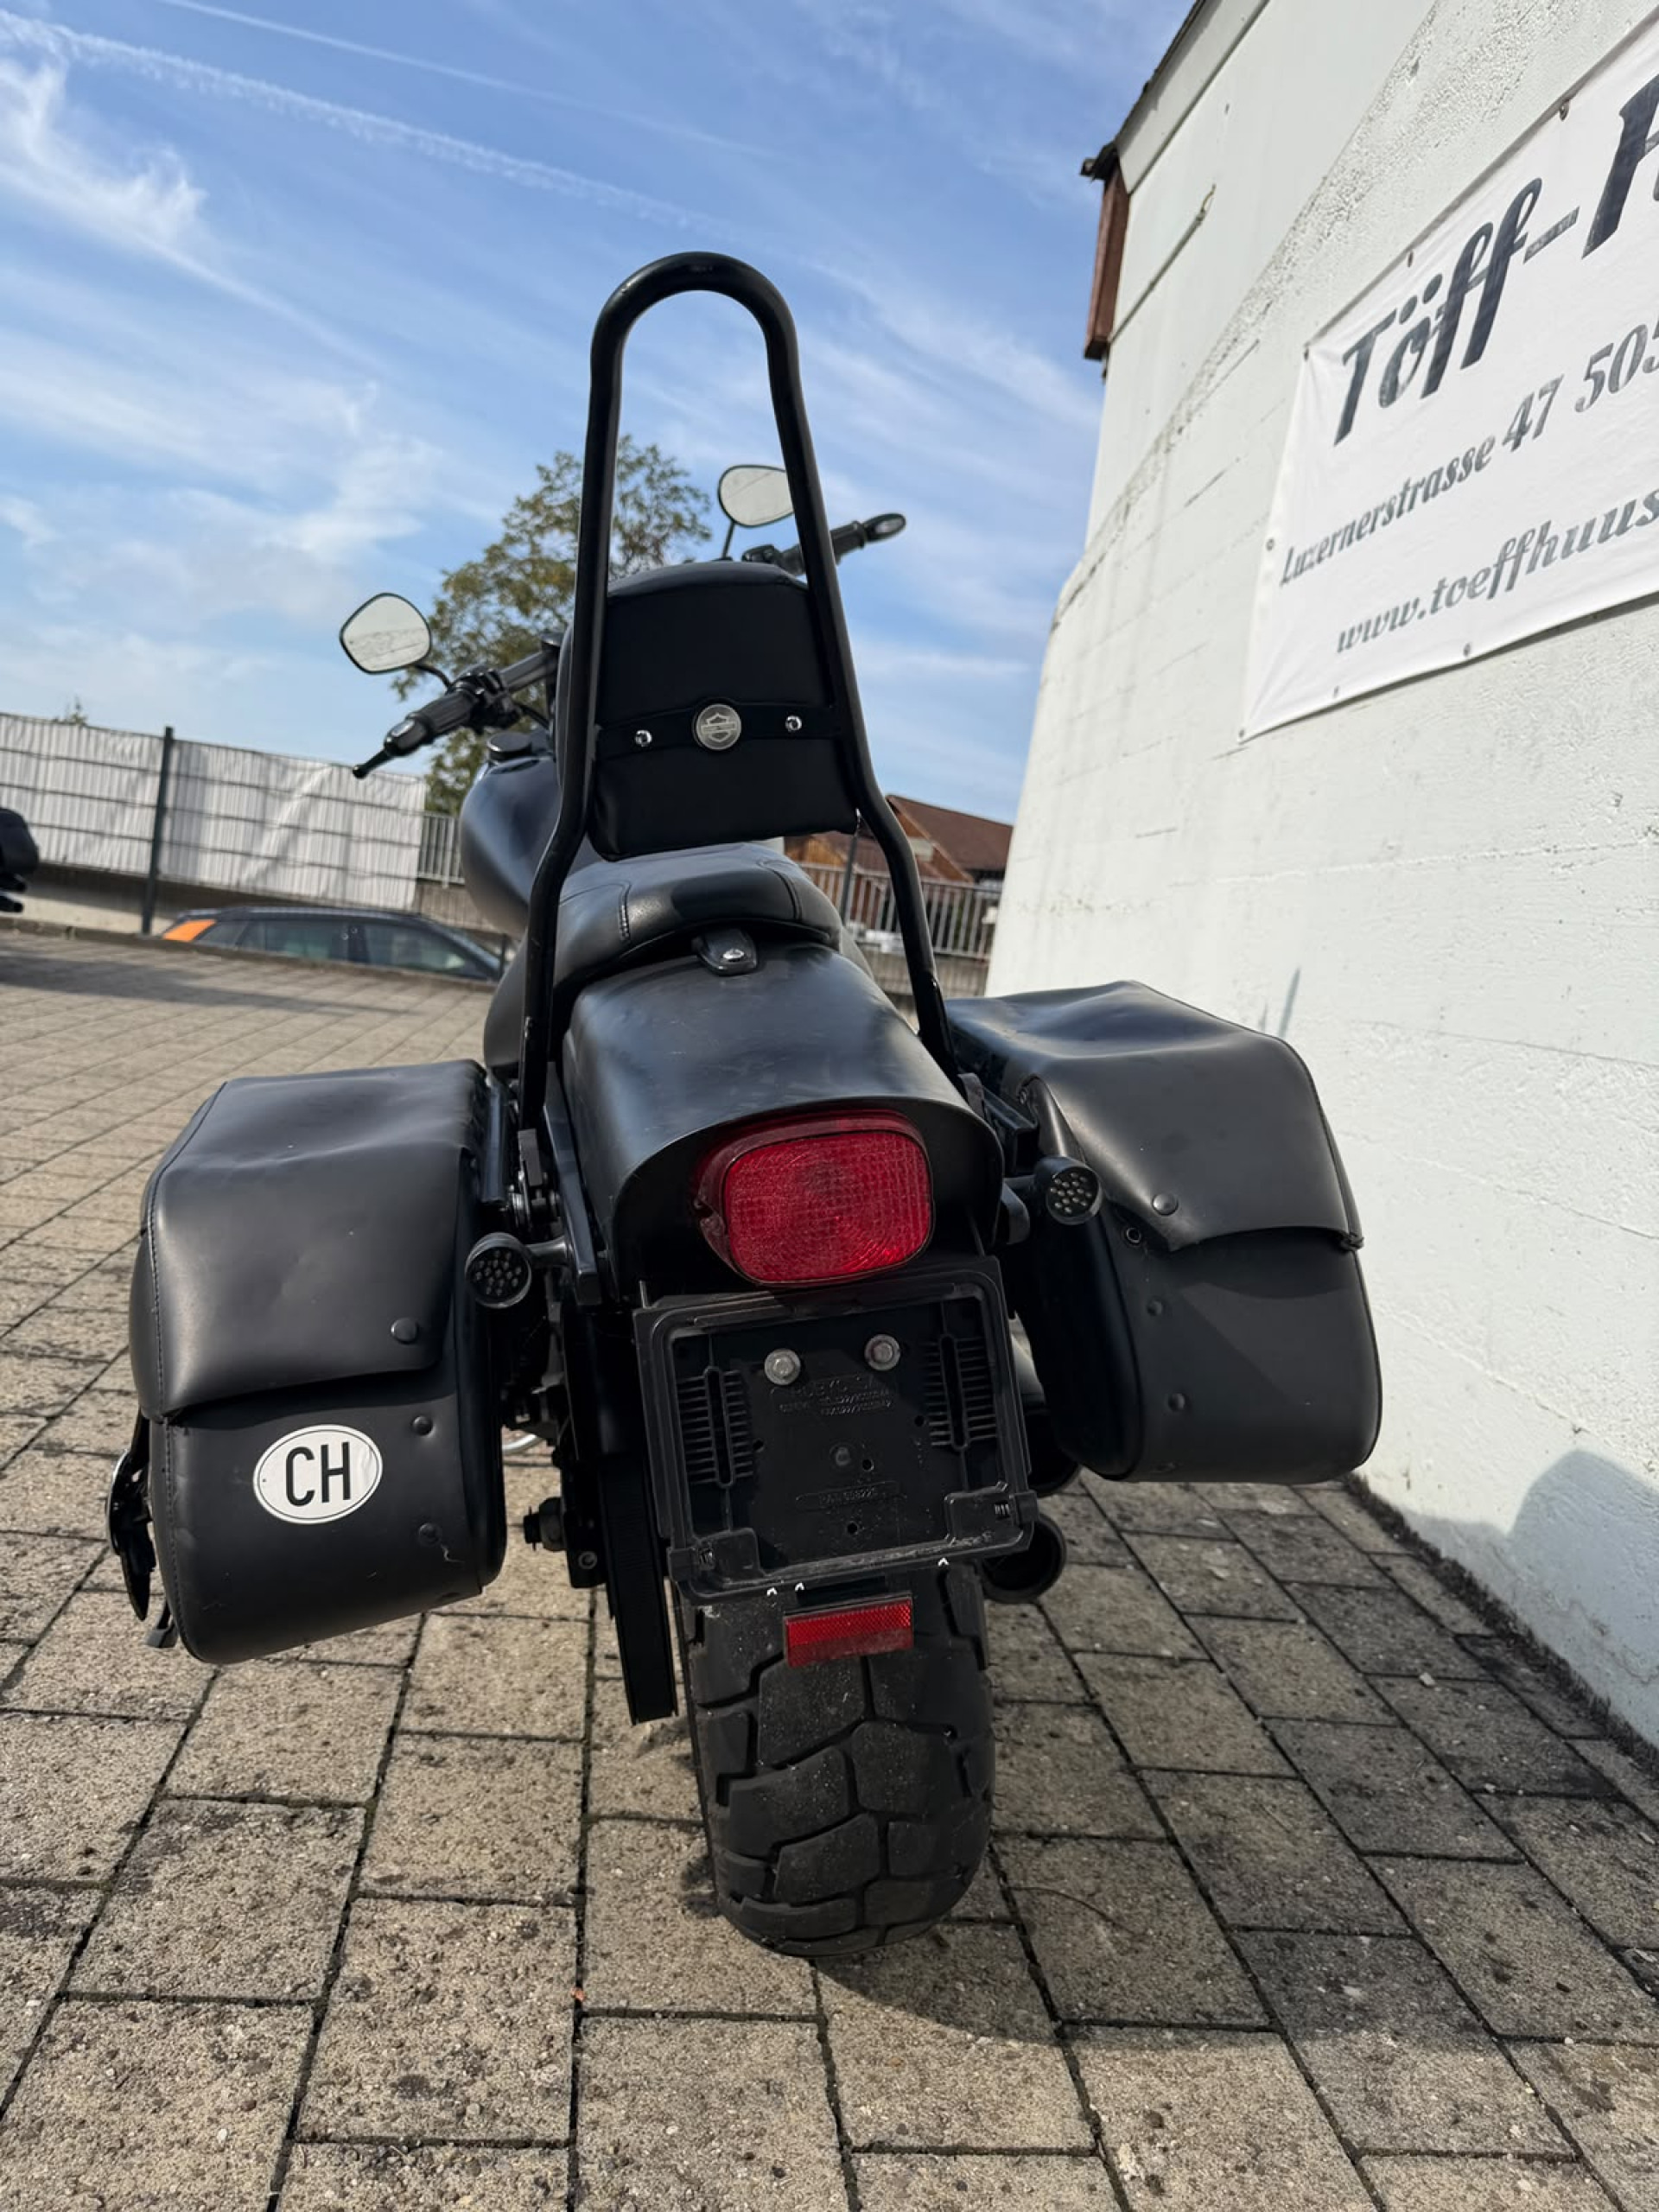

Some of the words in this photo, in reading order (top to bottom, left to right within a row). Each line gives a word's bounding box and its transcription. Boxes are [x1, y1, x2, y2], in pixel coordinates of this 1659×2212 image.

[1281, 435, 1496, 587] Luzernerstrasse
[1502, 373, 1564, 452] 47
[1337, 488, 1659, 653] www.toeffhuus
[286, 1441, 351, 1507] CH
